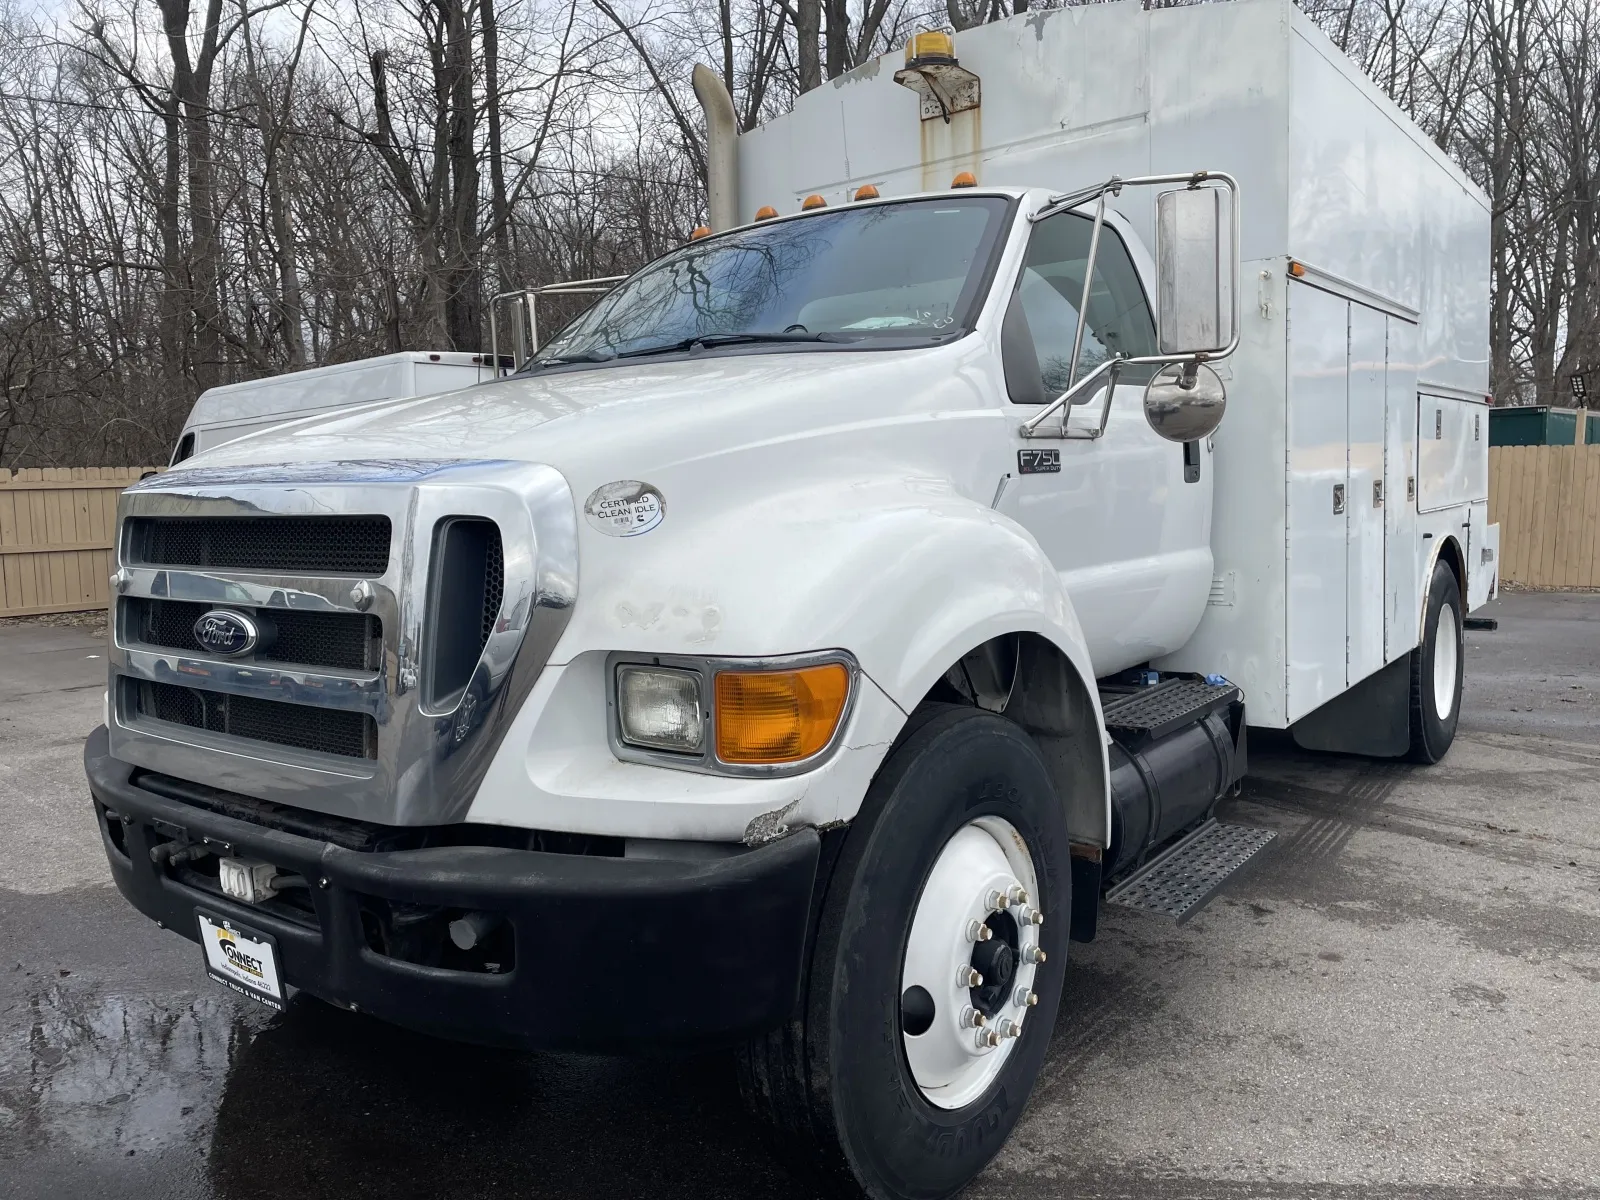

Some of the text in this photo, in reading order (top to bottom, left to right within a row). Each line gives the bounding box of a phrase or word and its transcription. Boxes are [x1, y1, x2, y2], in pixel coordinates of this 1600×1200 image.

[597, 504, 656, 519] CLEAN IDLE
[202, 618, 235, 645] Ford
[208, 972, 228, 986] CONNECT
[229, 980, 244, 993] TRUCK
[250, 991, 261, 1002] VAN
[261, 997, 282, 1010] CENTER
